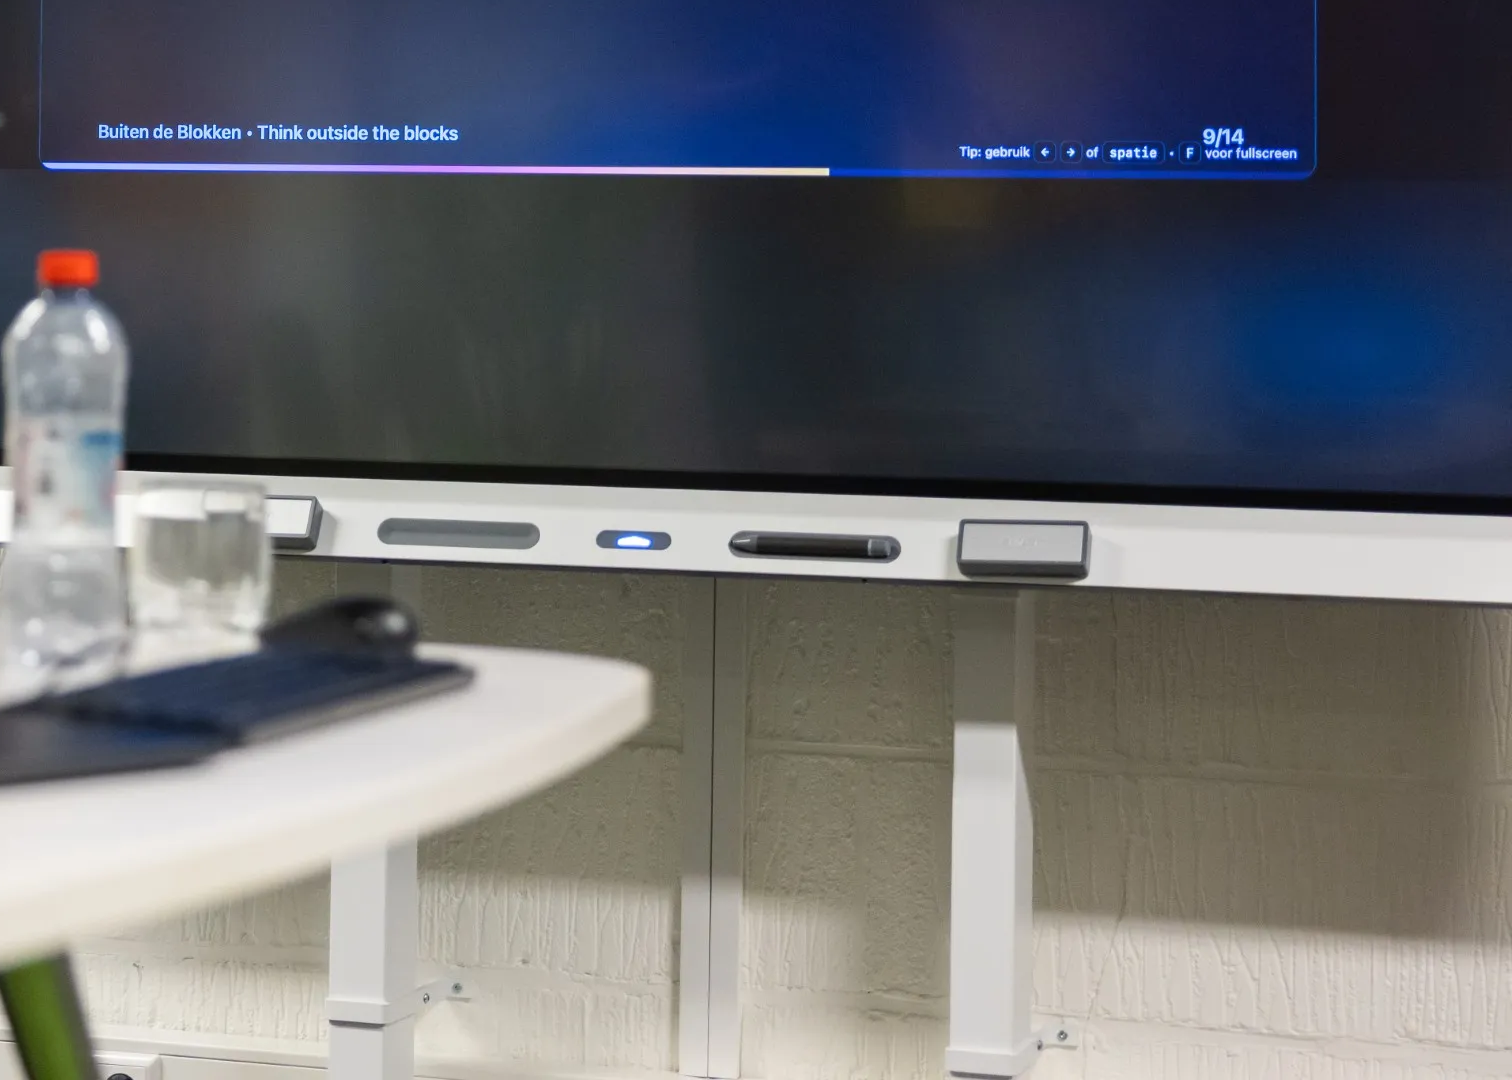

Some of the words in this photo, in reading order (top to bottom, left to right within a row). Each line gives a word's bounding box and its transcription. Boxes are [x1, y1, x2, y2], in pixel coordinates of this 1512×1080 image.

[99, 124, 149, 138] Buiten
[153, 124, 173, 139] de
[178, 125, 241, 139] Blokken
[257, 125, 303, 139] Think
[307, 125, 368, 140] outside
[372, 125, 399, 140] the
[405, 125, 458, 140] blocks
[1203, 128, 1244, 147] 9/14
[959, 146, 981, 159] Tip:
[985, 146, 1030, 159] gebruik
[1086, 147, 1098, 157] of
[1110, 146, 1157, 160] spatie
[1186, 147, 1195, 159] F
[1205, 149, 1233, 158] voor
[1236, 147, 1297, 159] fullscreen
